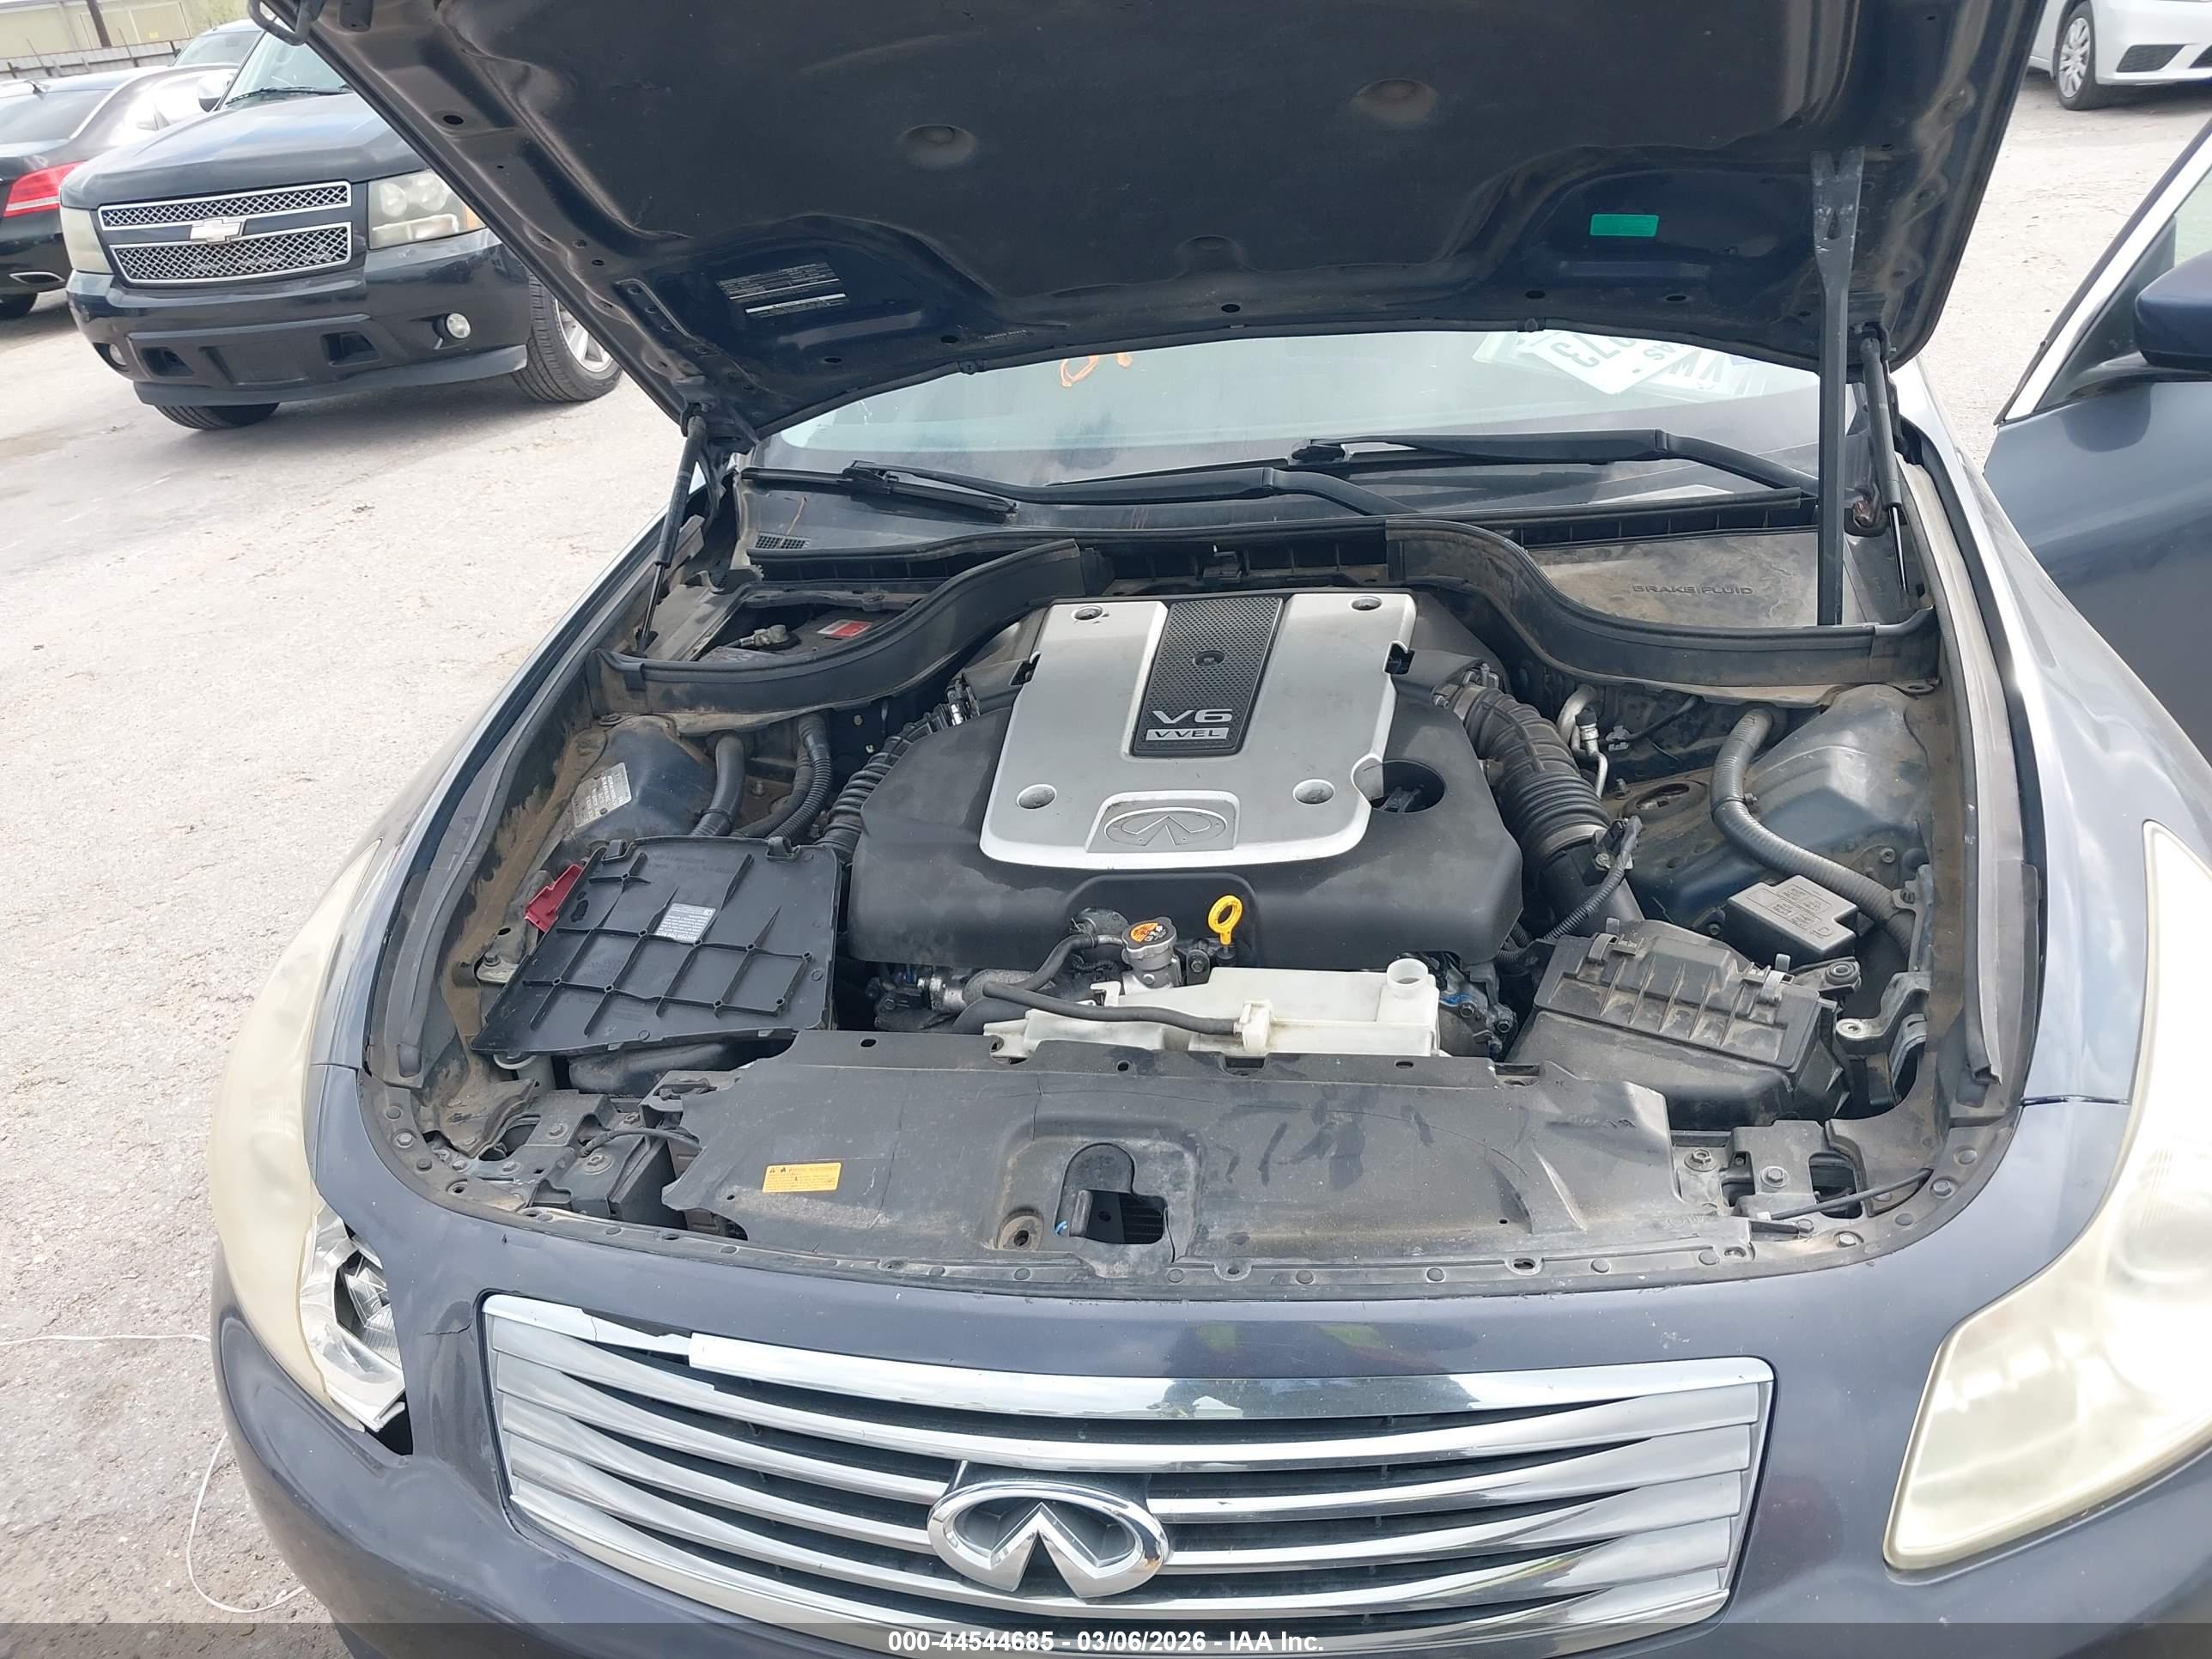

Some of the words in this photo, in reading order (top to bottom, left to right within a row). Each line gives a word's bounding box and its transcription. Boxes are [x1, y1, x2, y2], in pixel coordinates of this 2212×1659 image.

[1632, 585, 1697, 593] BRAKE
[1152, 708, 1233, 724] V6
[1154, 729, 1220, 738] VVEL
